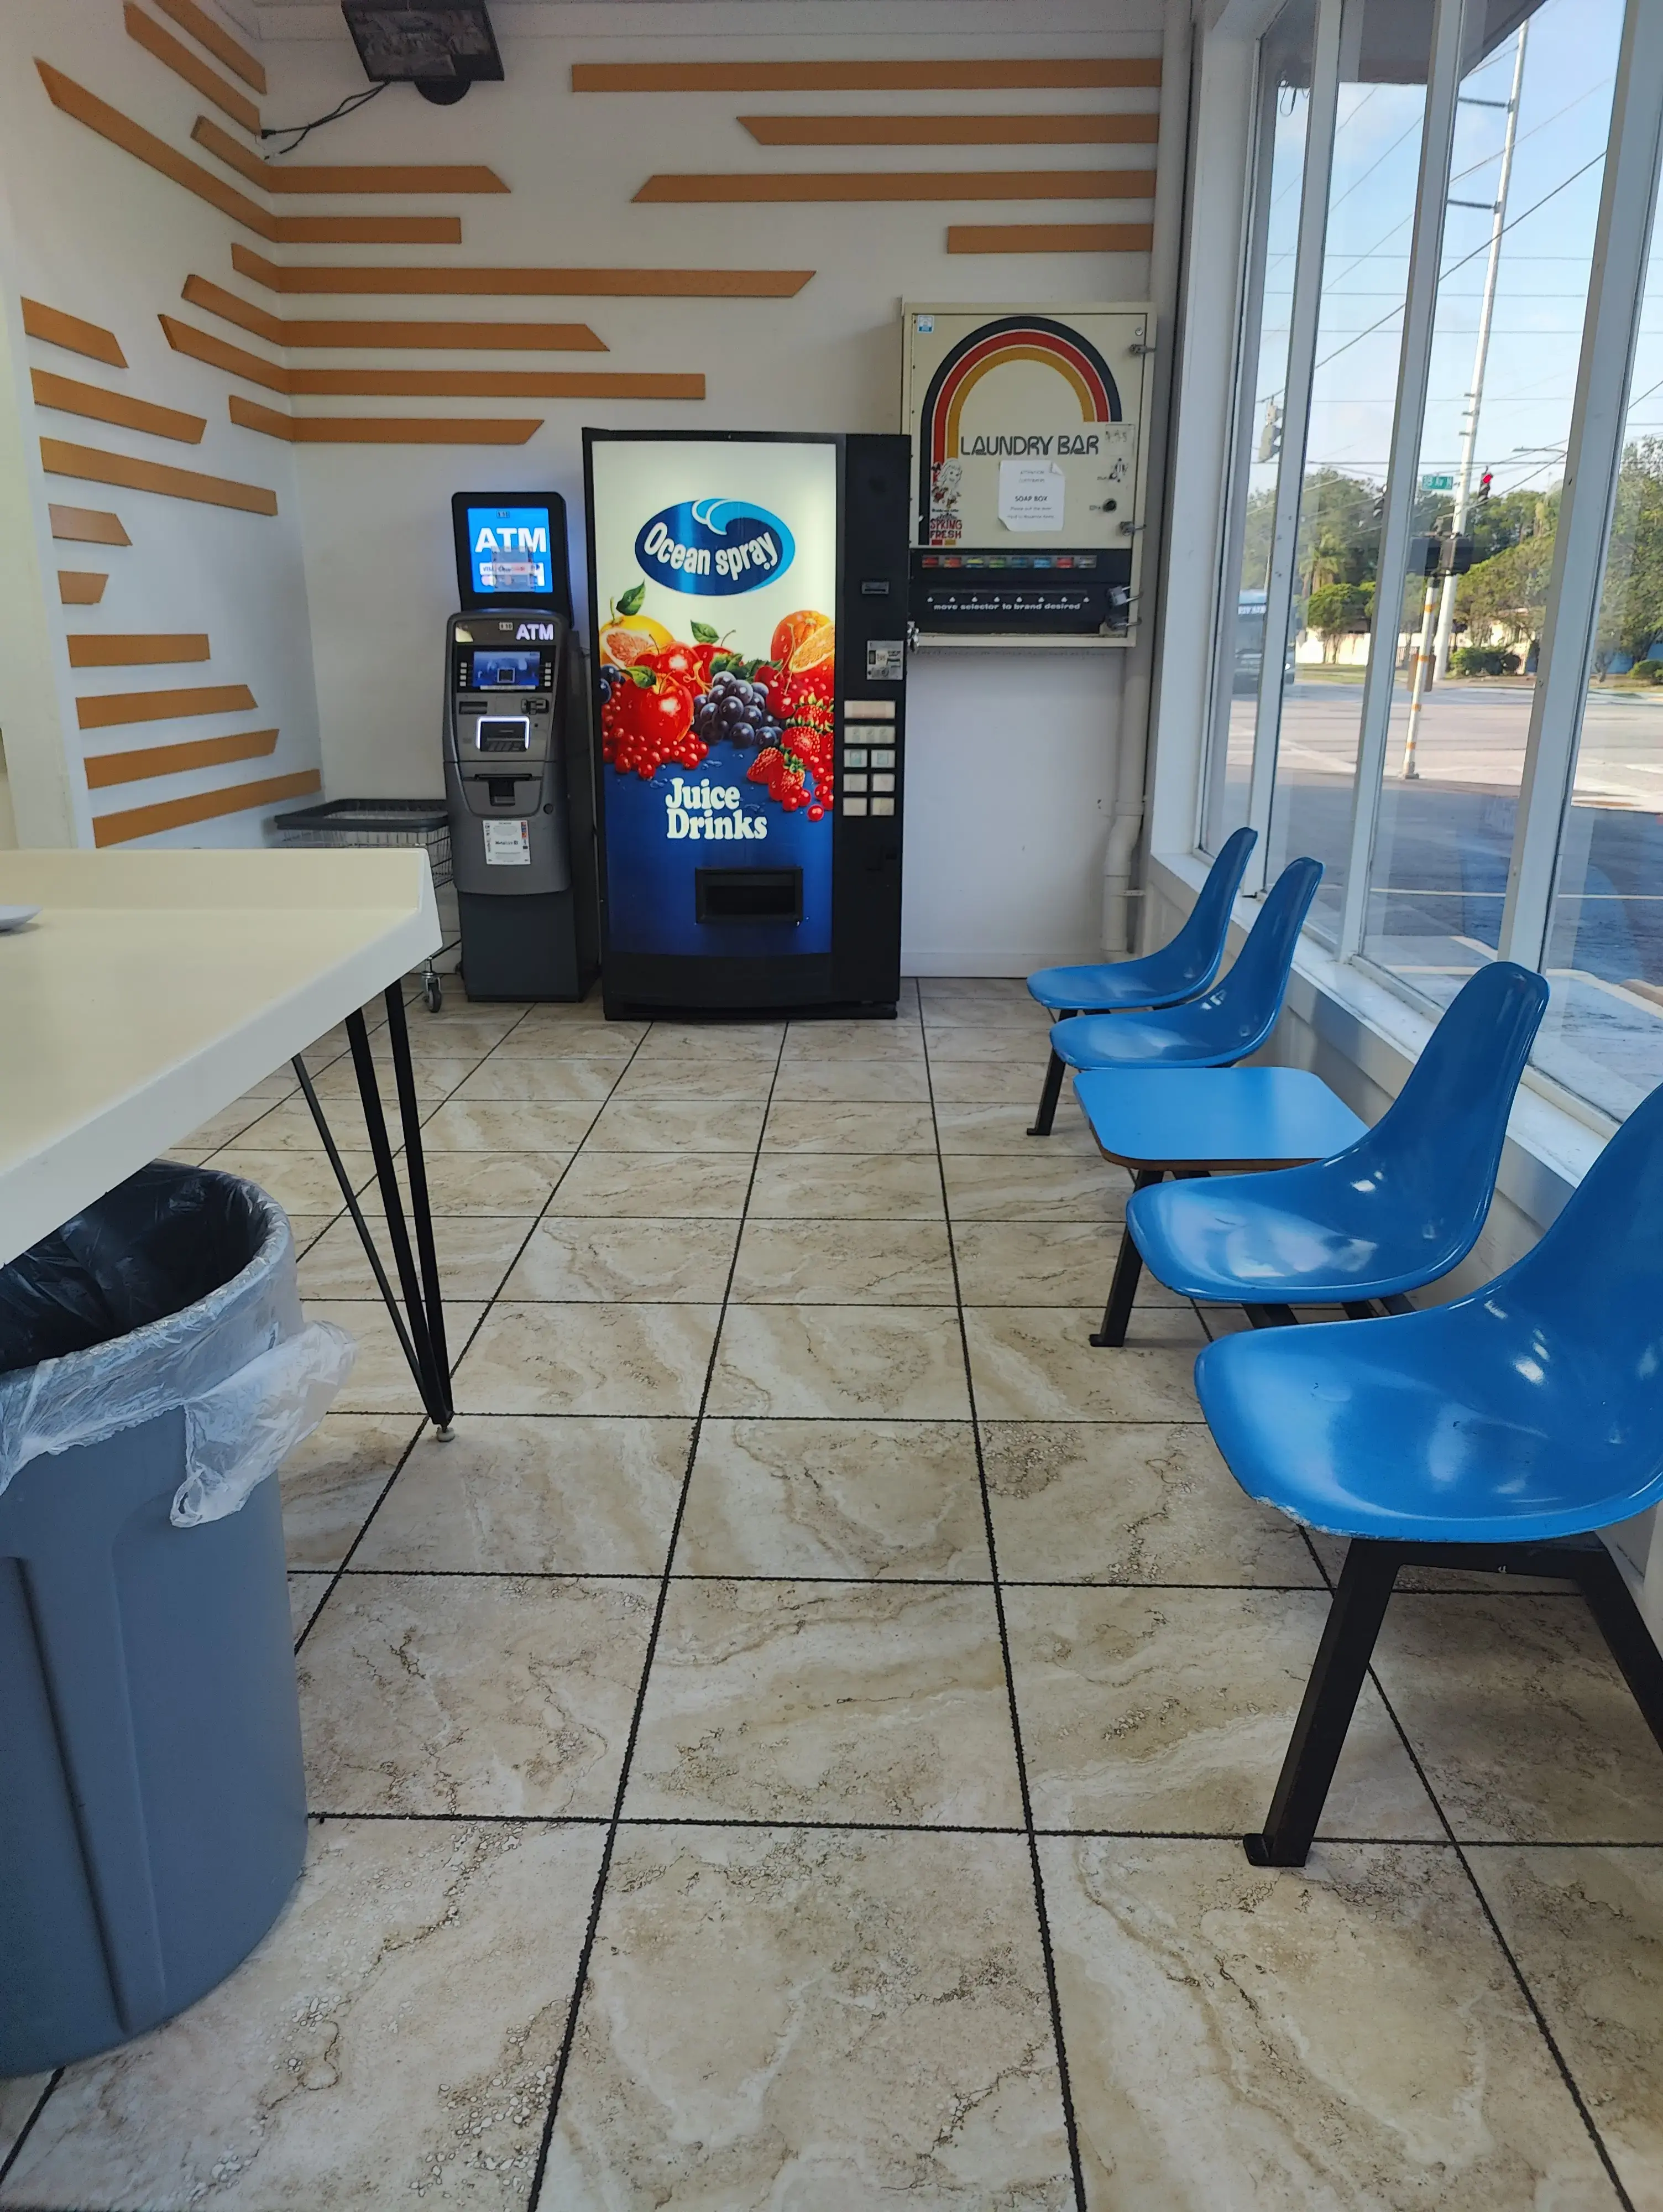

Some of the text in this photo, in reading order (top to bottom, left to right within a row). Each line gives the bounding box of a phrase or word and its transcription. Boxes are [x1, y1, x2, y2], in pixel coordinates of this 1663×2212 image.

[961, 435, 1054, 456] LAUNDRY
[1057, 435, 1099, 455] BAR
[930, 519, 963, 530] SPRING
[930, 530, 961, 539] FRESH
[475, 528, 547, 553] ATM
[644, 521, 778, 581] Ocean spray
[516, 624, 553, 640] ATM
[665, 778, 740, 810] Juice
[667, 808, 767, 839] Drinks
